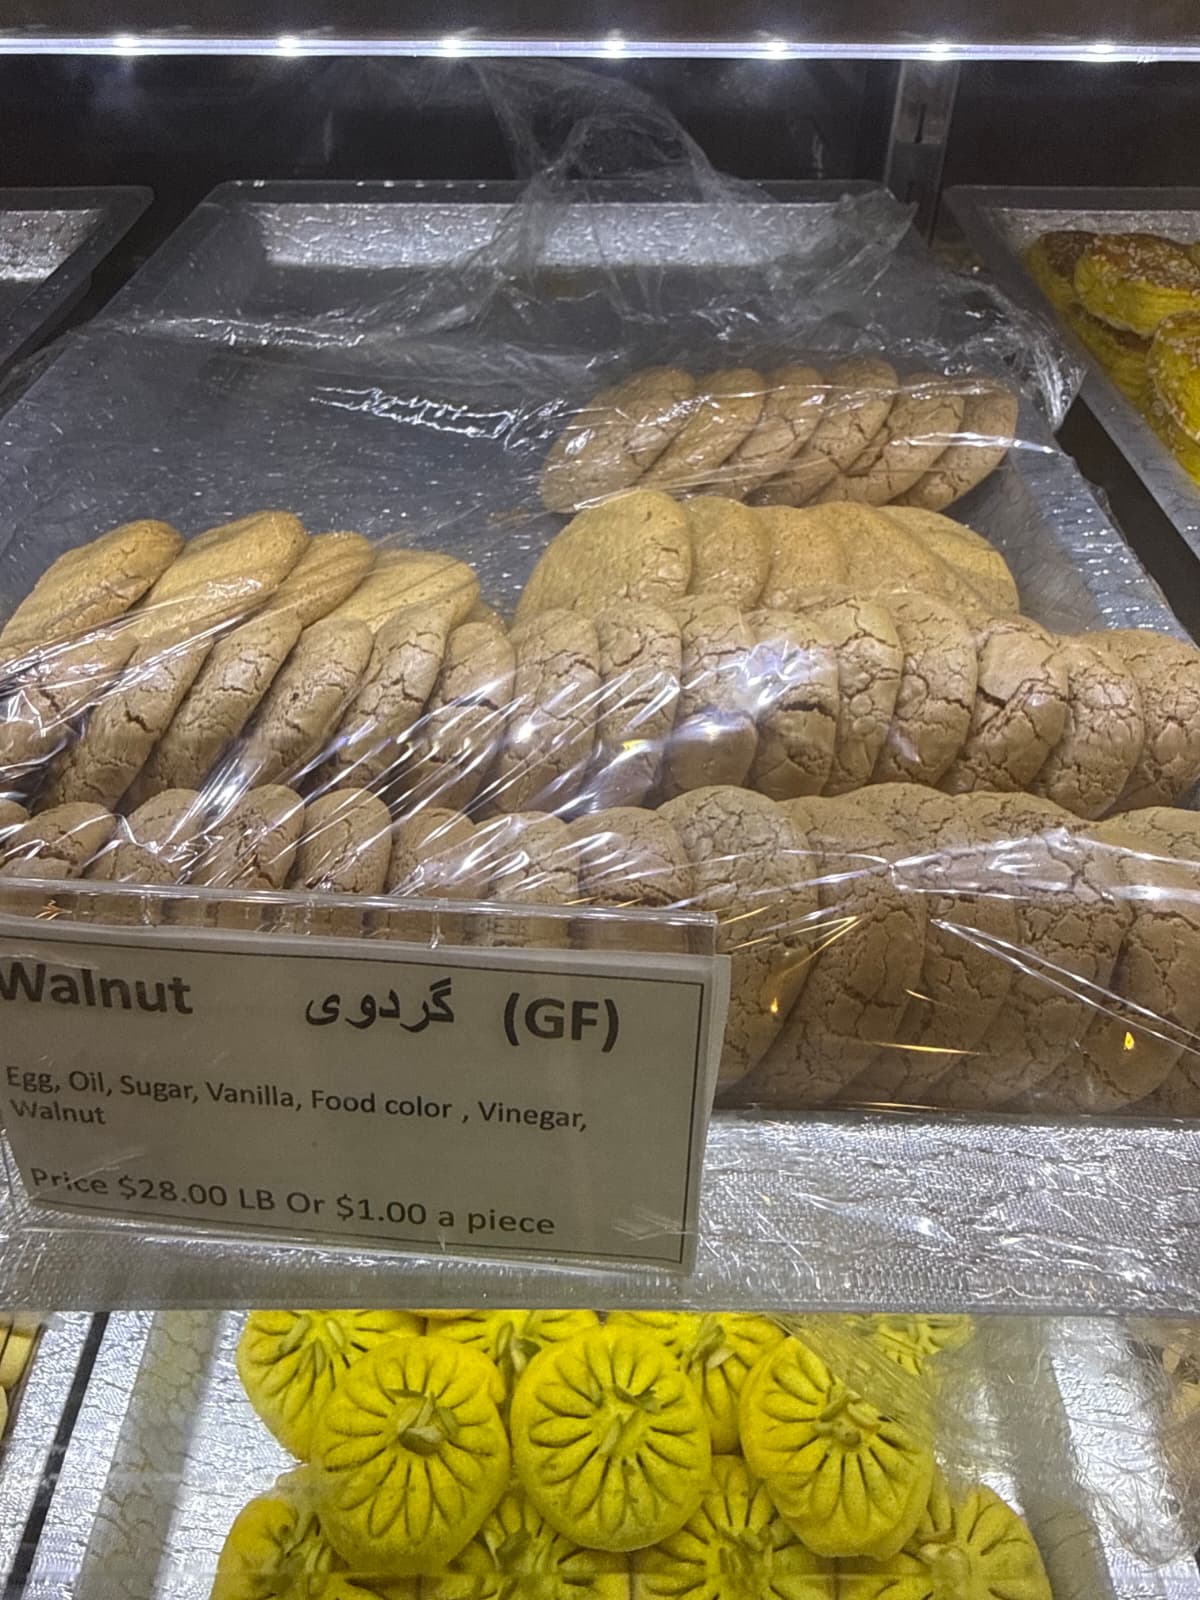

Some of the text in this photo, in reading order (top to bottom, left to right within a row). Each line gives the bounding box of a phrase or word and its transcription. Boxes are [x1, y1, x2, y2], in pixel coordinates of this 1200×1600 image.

[0, 961, 194, 1015] Walnut
[305, 977, 455, 1034] گردوی
[504, 992, 619, 1053] (GF)
[6, 1065, 61, 1094] Egg,
[69, 1071, 112, 1097] Oil,
[120, 1075, 198, 1104] Sugar,
[206, 1082, 302, 1111] Vanilla,
[311, 1089, 376, 1113] Food
[385, 1096, 453, 1119] color
[478, 1101, 587, 1132] Vinegar,
[11, 1099, 106, 1125] Walnut
[31, 1167, 556, 1235] Price $28.00 LB Or $1.00 a piece
